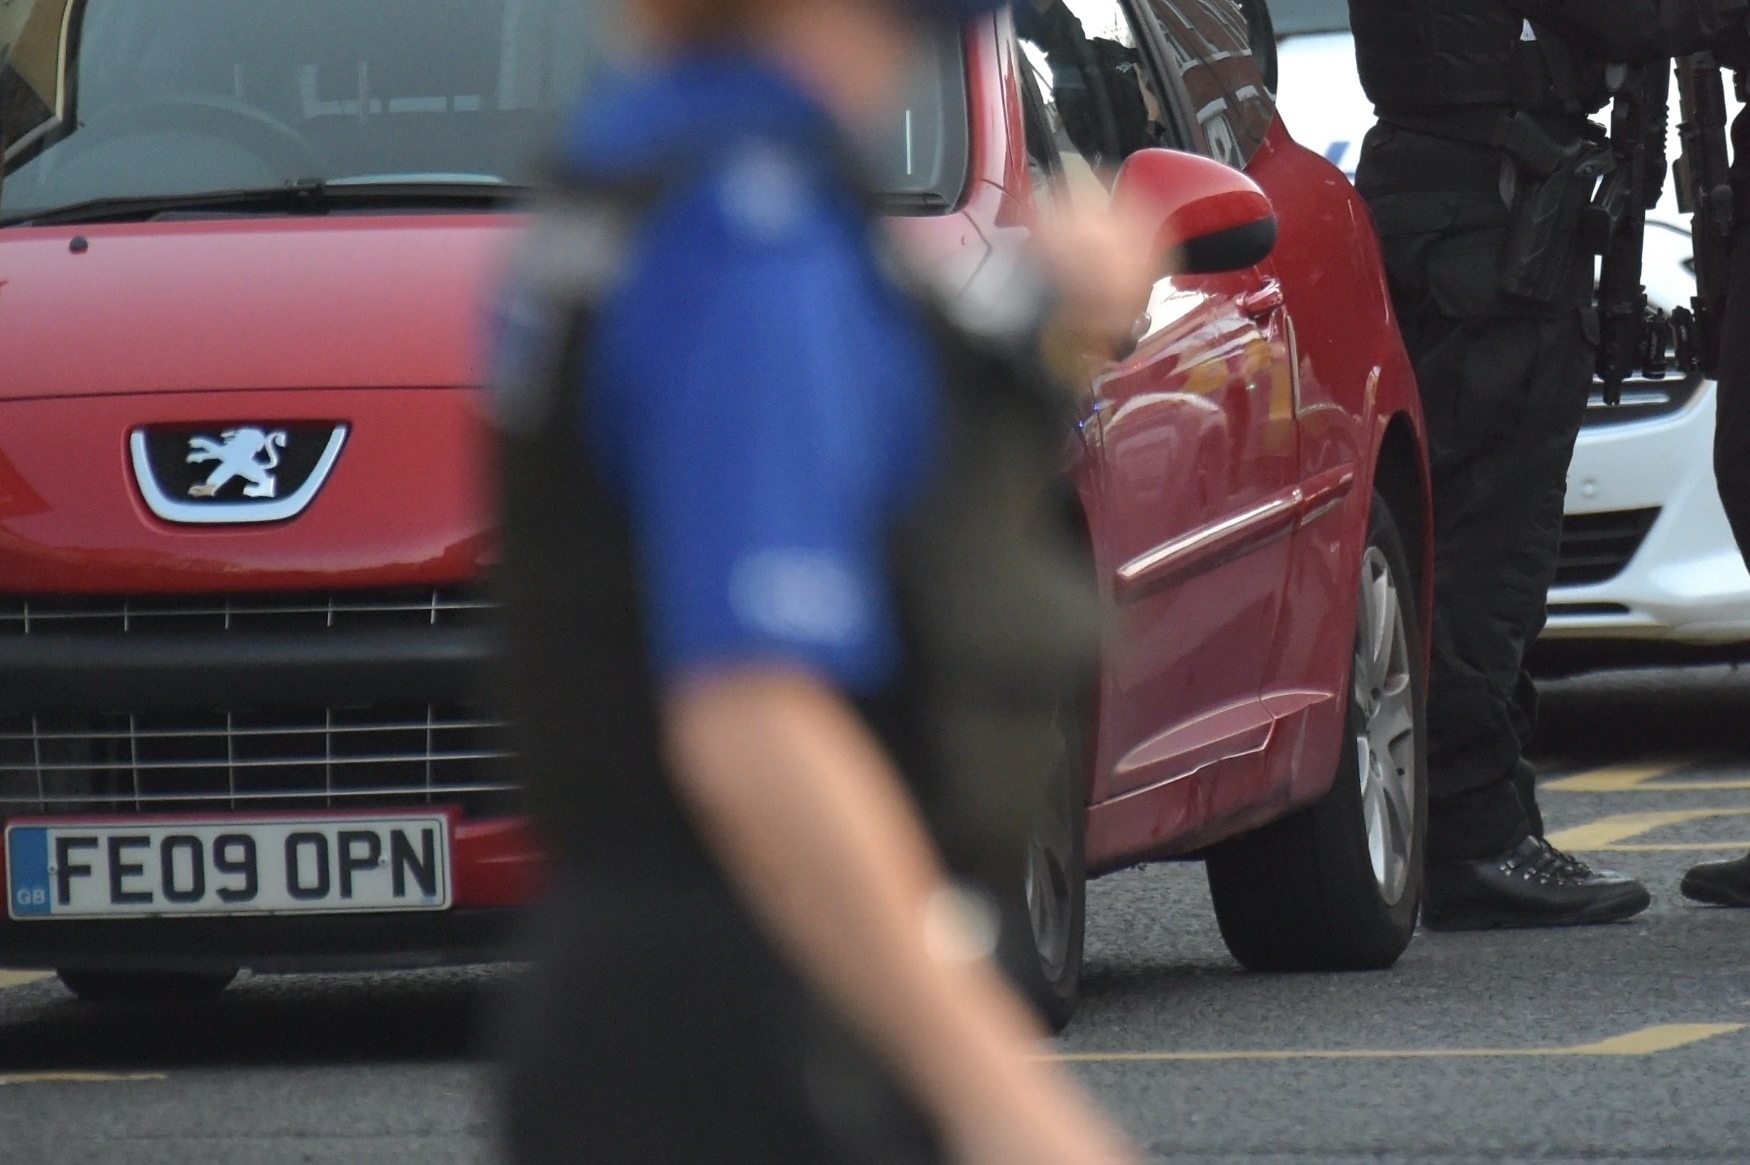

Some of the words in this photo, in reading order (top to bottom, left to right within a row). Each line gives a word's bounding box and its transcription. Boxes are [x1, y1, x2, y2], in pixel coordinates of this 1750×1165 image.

[55, 833, 259, 906] FE09
[284, 828, 438, 900] OPN
[16, 888, 46, 905] GB
